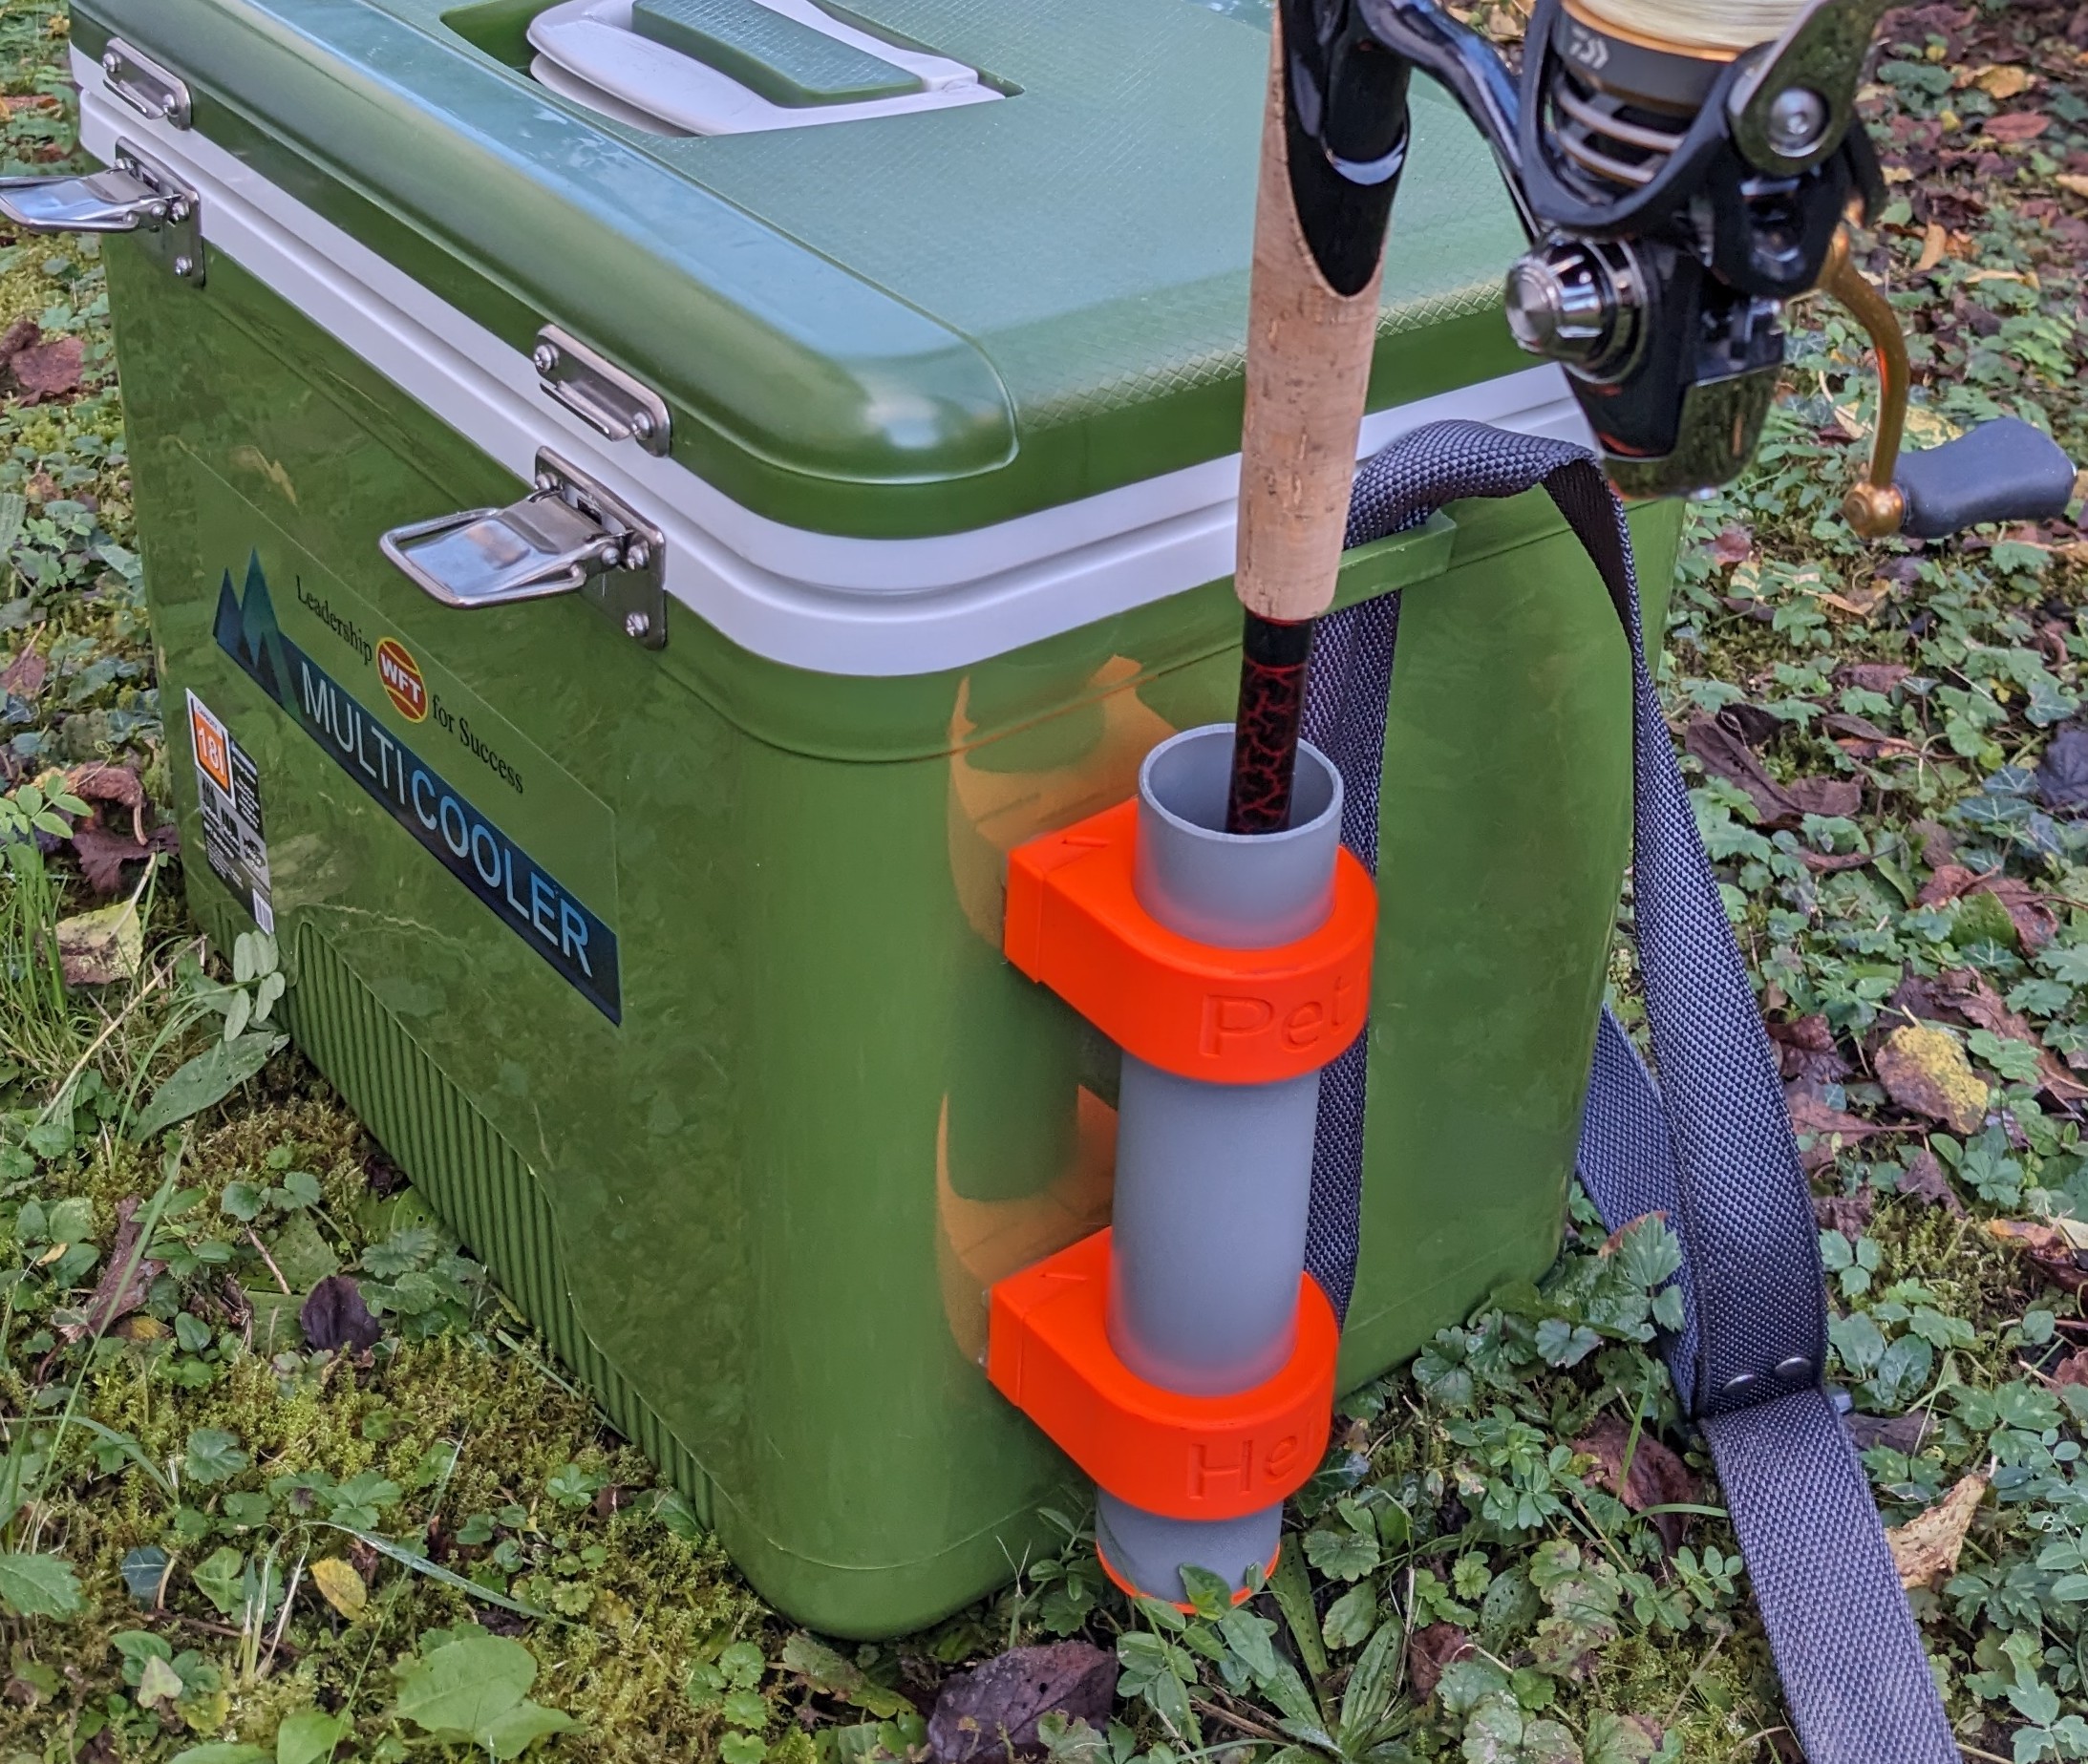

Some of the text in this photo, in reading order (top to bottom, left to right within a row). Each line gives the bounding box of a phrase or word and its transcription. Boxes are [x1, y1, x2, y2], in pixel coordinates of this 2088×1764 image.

[296, 574, 523, 795] Leadership WFT for Success
